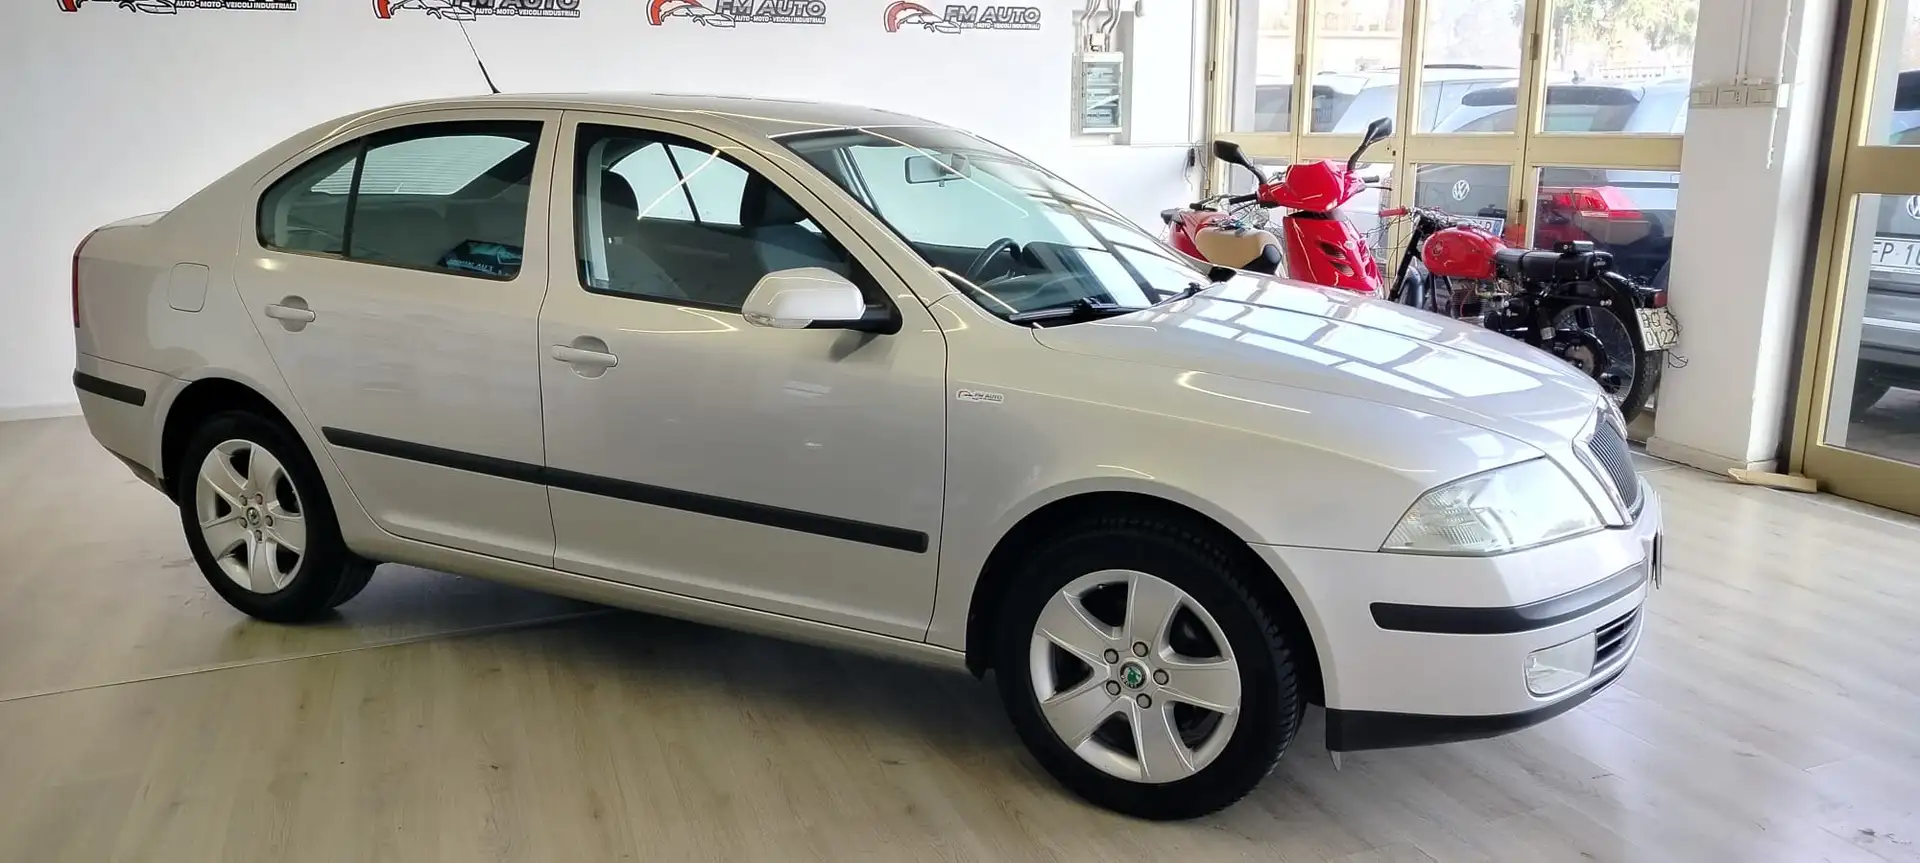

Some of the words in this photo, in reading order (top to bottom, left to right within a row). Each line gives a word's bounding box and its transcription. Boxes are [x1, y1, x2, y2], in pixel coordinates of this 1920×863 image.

[253, 2, 296, 10] INDUSTRIALI
[716, 0, 754, 15] FM
[757, 0, 826, 17] AUTO
[944, 5, 978, 23] FM
[980, 6, 1040, 24] AUTO
